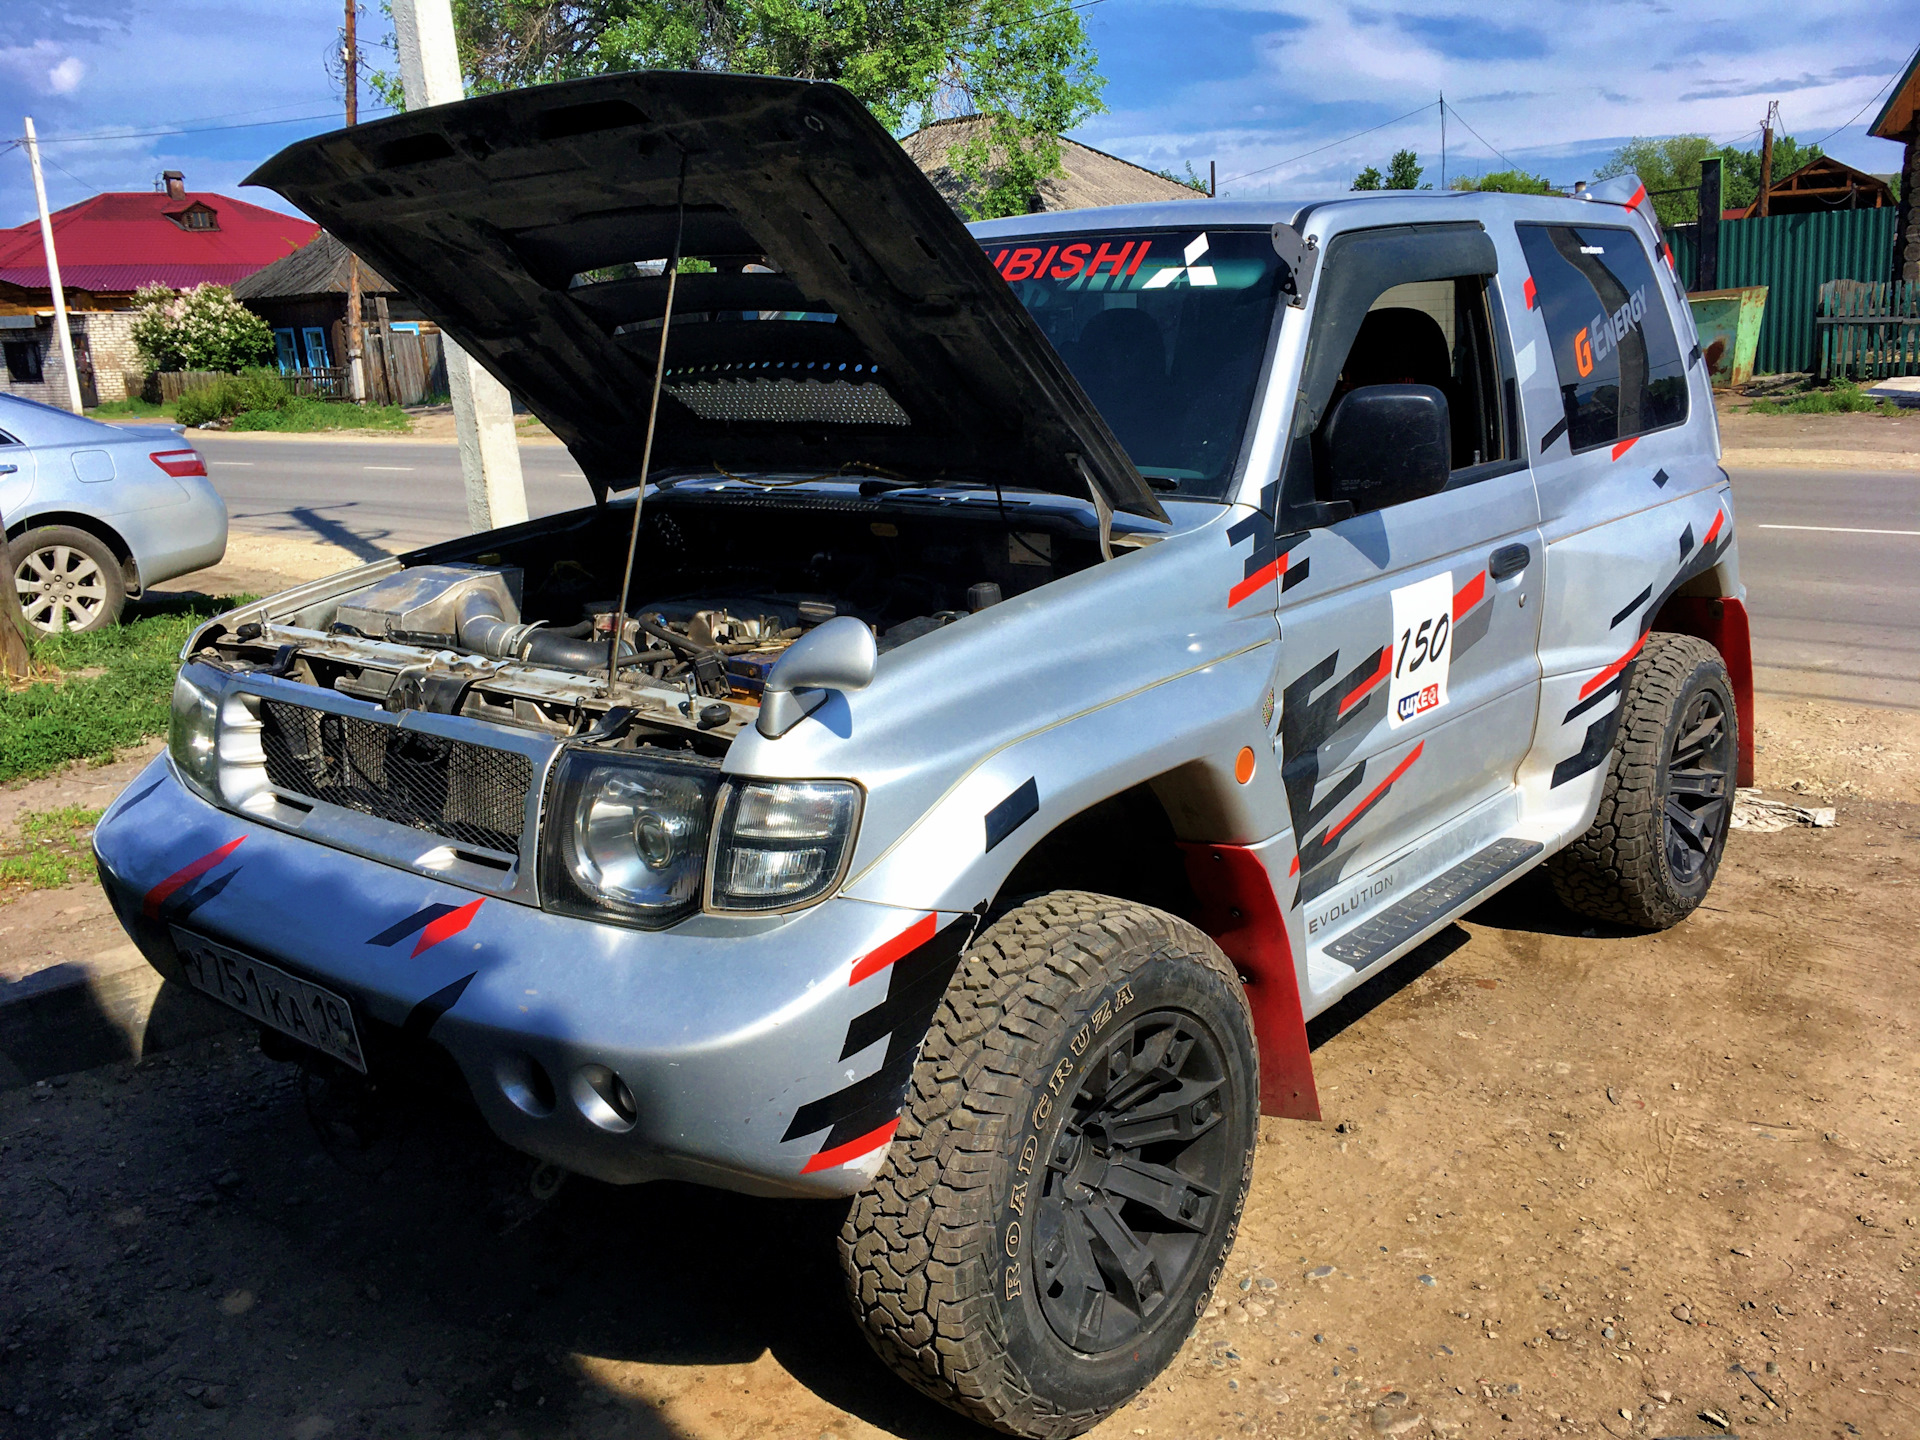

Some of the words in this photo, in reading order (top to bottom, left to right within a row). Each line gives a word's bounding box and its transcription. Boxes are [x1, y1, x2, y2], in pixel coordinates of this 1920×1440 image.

[1395, 612, 1449, 679] 150
[1308, 874, 1393, 935] EVOLUTION
[312, 994, 344, 1035] 19
[1004, 983, 1136, 1302] ROADCRUZA
